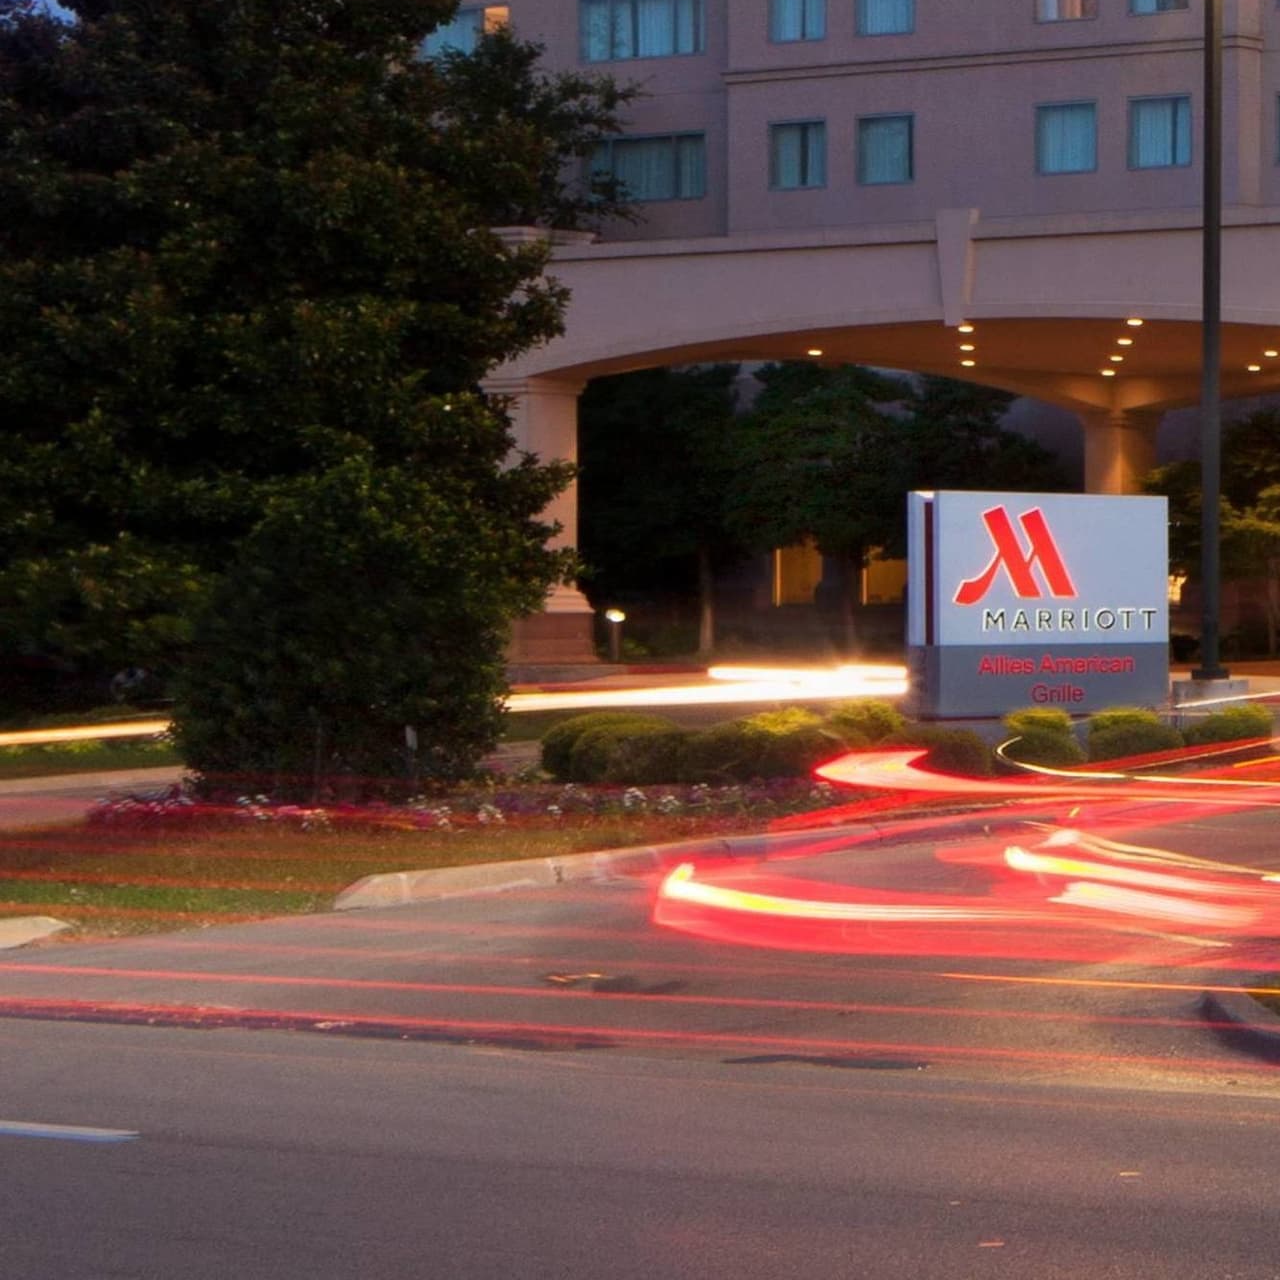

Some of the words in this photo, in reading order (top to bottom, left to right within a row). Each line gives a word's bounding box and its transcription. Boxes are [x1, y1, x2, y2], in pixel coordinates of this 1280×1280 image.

[983, 608, 1157, 632] MARRIOTT
[978, 655, 1034, 675] Allies
[1040, 653, 1134, 675] American
[1031, 684, 1085, 704] Grille
